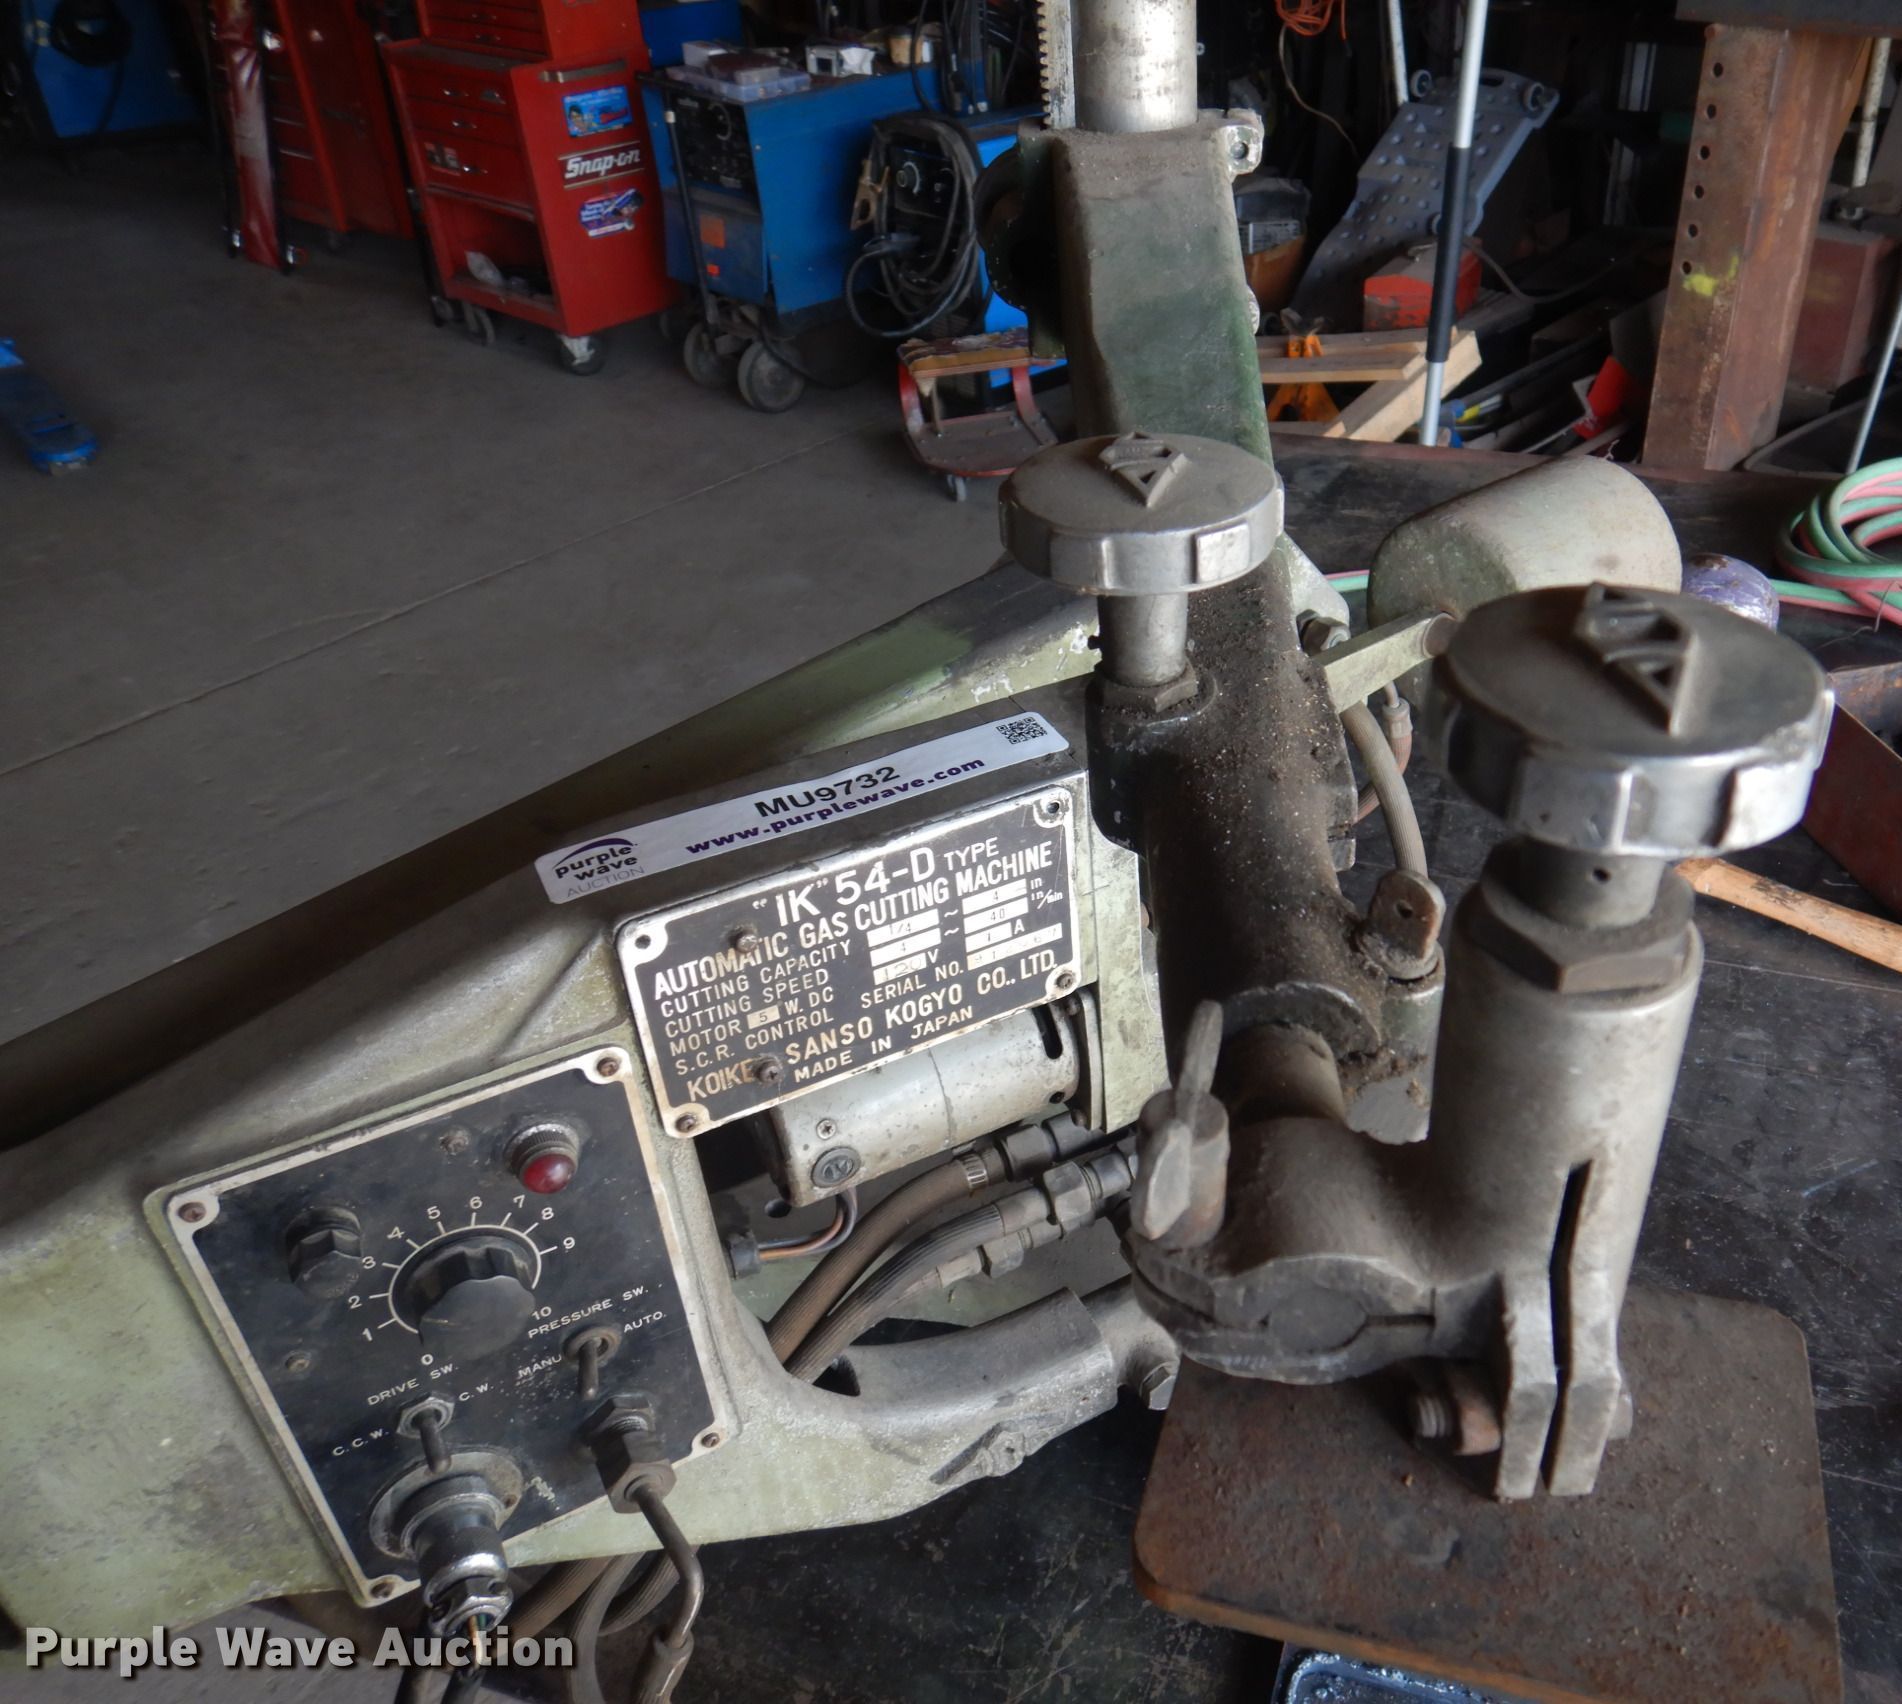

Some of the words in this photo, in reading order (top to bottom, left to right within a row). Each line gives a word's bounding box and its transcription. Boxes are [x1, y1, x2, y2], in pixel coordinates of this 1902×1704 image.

[564, 148, 641, 181] Snap-on
[686, 758, 985, 854] www.purplewave.com
[754, 766, 900, 817] MU9732
[555, 846, 632, 879] purple
[574, 856, 638, 880] wave
[835, 847, 935, 905] 54-D
[944, 837, 999, 871] TYPE
[567, 866, 645, 898] AUCTION
[655, 931, 789, 1001] AUTOMATIC
[799, 911, 849, 948] GAS
[854, 877, 949, 931] CUTTING
[955, 841, 1052, 896] MACHINE
[660, 974, 750, 1018] CUTTING
[760, 939, 850, 984] CAPACITY
[669, 1019, 742, 1057] MOTOR
[759, 1011, 768, 1024] 5
[809, 986, 834, 1008] DC
[928, 949, 939, 964] V
[1014, 919, 1025, 934] A
[665, 995, 751, 1038] CUTTING
[762, 969, 829, 1003] SPEED
[745, 1008, 834, 1050] CONTROL
[860, 974, 927, 1009] SERIAL
[935, 961, 964, 982] NO.
[686, 1058, 754, 1102] KOIKE
[785, 1016, 873, 1065] SANSO
[885, 983, 963, 1030] KOGYO
[794, 1050, 853, 1083] MADE
[871, 1036, 892, 1055] IN
[911, 1005, 973, 1039] JAPAN
[427, 1206, 441, 1220] 5
[469, 1196, 483, 1209] 6
[513, 1194, 527, 1209] 7
[541, 1207, 555, 1221] 8
[386, 1226, 405, 1240] 4
[563, 1237, 576, 1250] 9
[362, 1256, 377, 1269] 3
[348, 1295, 363, 1309] 2
[531, 1305, 552, 1320] 10
[362, 1327, 374, 1342] 1
[527, 1298, 613, 1339] PRESSURE
[420, 1353, 434, 1366] 0
[367, 1378, 420, 1406] DRIVE
